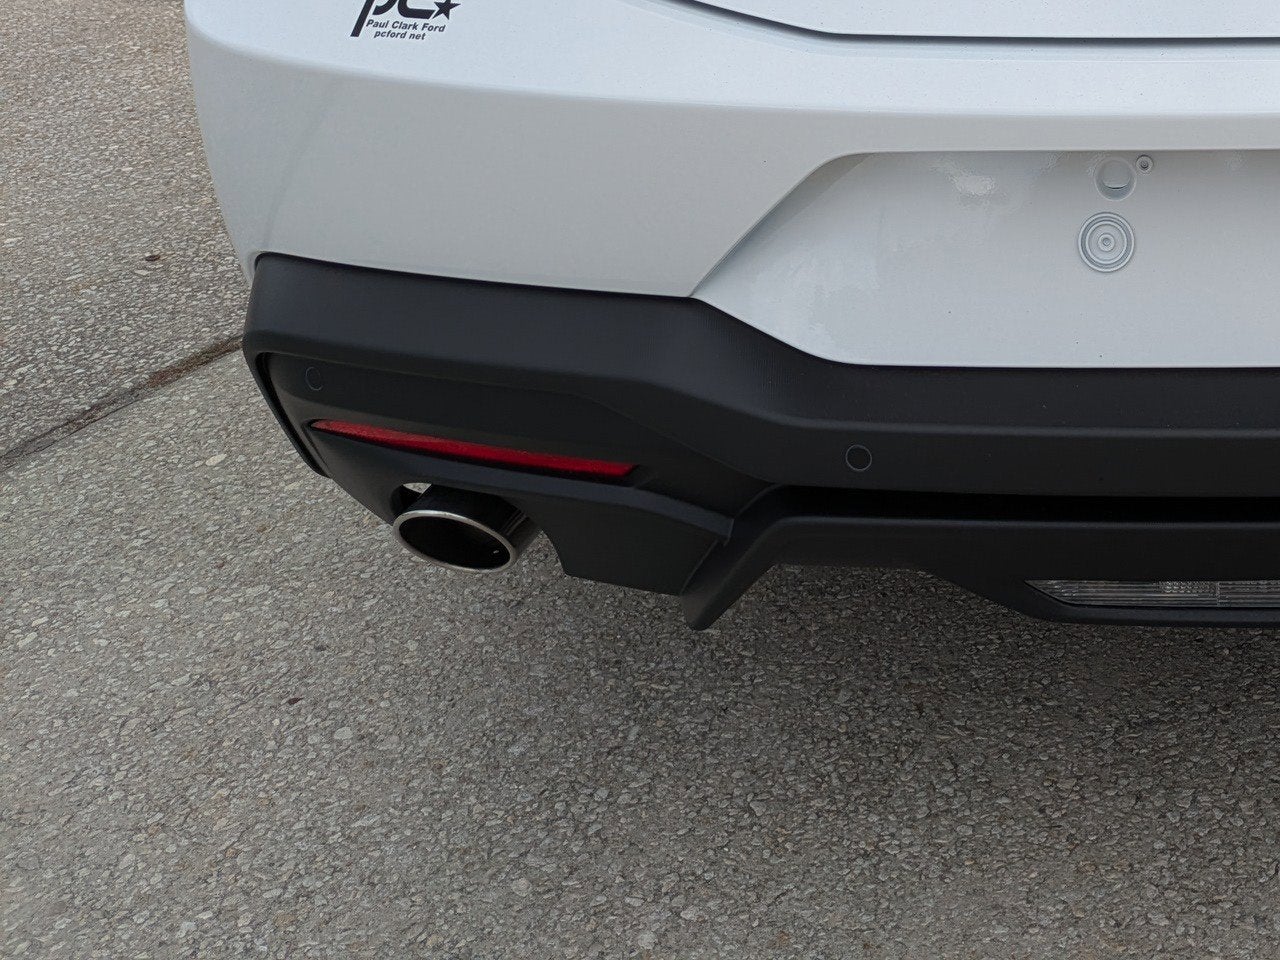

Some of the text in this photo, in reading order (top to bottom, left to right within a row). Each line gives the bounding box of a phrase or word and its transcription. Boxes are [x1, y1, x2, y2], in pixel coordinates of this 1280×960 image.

[366, 19, 446, 33] Paul Clark Ford
